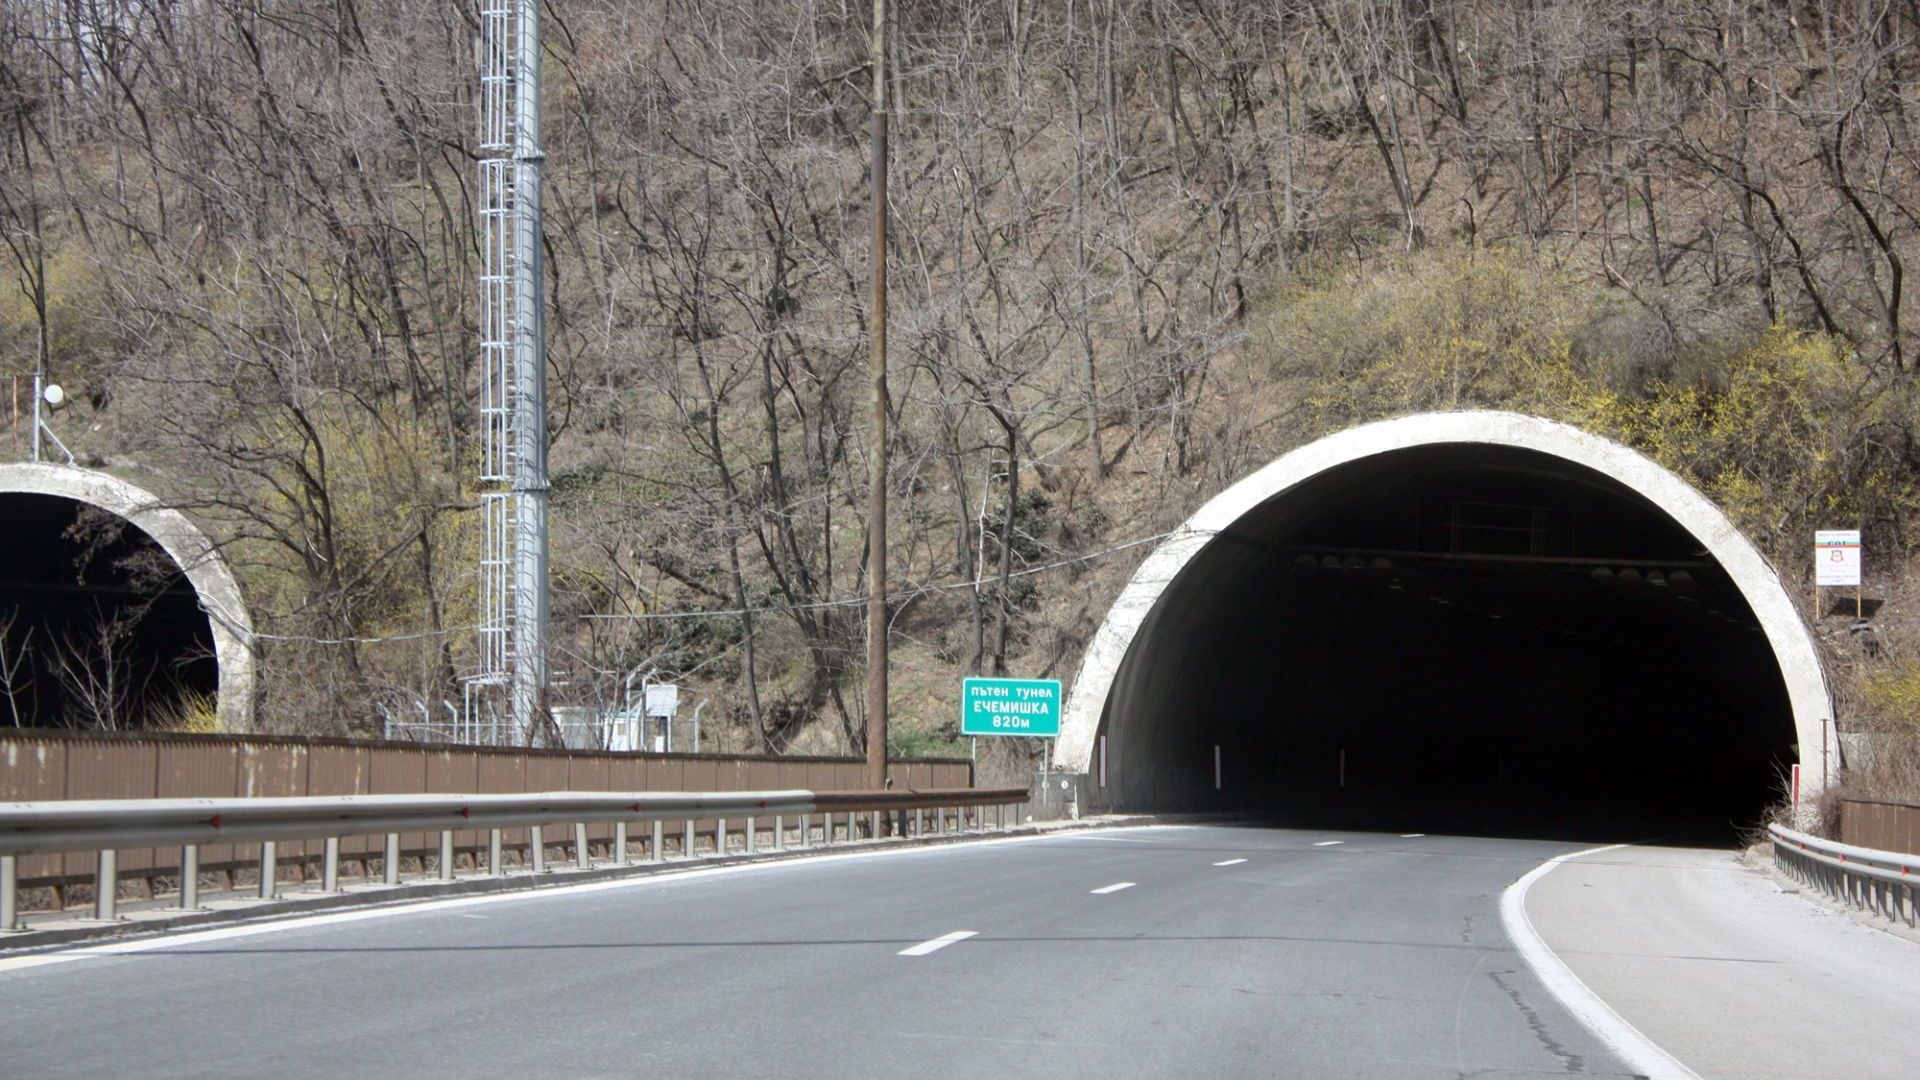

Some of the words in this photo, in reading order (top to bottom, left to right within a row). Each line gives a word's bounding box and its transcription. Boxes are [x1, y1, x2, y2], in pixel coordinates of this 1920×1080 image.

[971, 686, 1009, 697] пътен
[1016, 687, 1053, 700] тунел
[973, 700, 1049, 714] ЕЧЕМИШКА
[992, 715, 1030, 728] 820м
